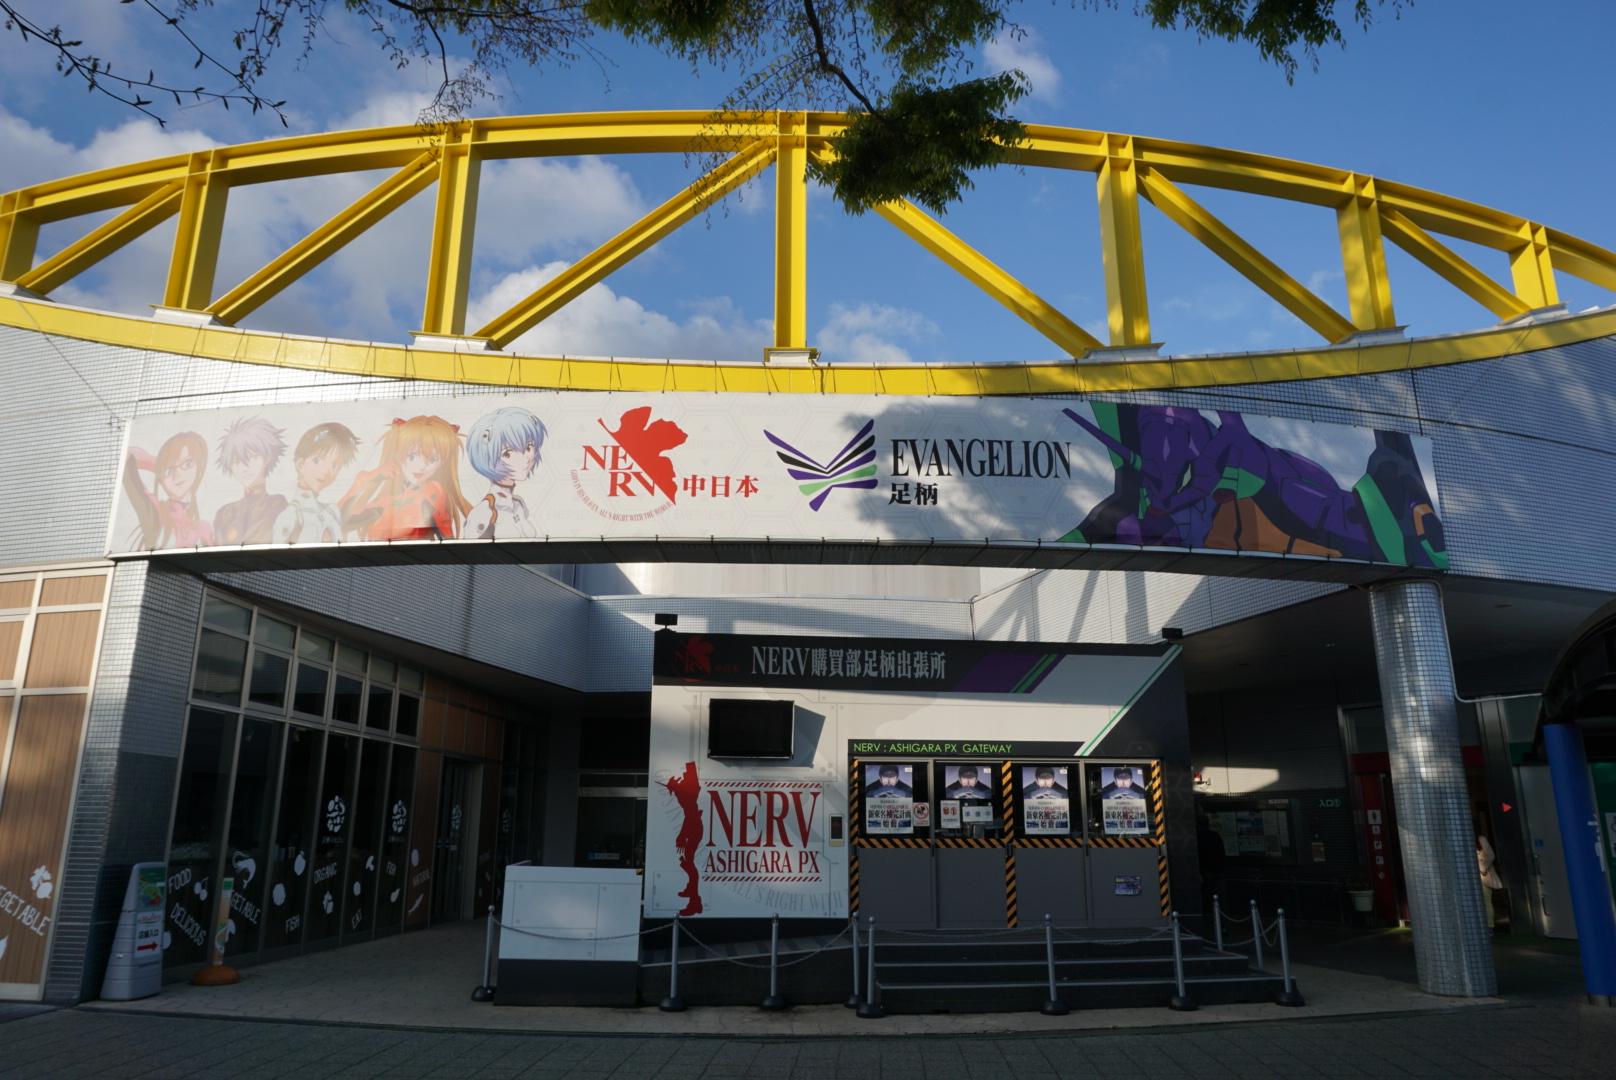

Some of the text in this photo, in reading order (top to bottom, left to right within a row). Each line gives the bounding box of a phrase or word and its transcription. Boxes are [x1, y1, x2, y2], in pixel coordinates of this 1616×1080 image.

[891, 438, 1072, 479] EVANGELION
[683, 474, 759, 498] 中日本
[888, 482, 938, 506] 足柄
[854, 743, 881, 752] NERV
[889, 743, 942, 753] ASHIGARA
[944, 744, 957, 753] PX
[962, 744, 1013, 754] GATEWAY
[706, 790, 821, 849] NERV
[705, 849, 820, 874] ASHIGARA PX
[168, 867, 192, 895] FOOD
[766, 888, 808, 912] RIGHT
[169, 902, 207, 947] DELICIOUS
[285, 913, 301, 936] FISH
